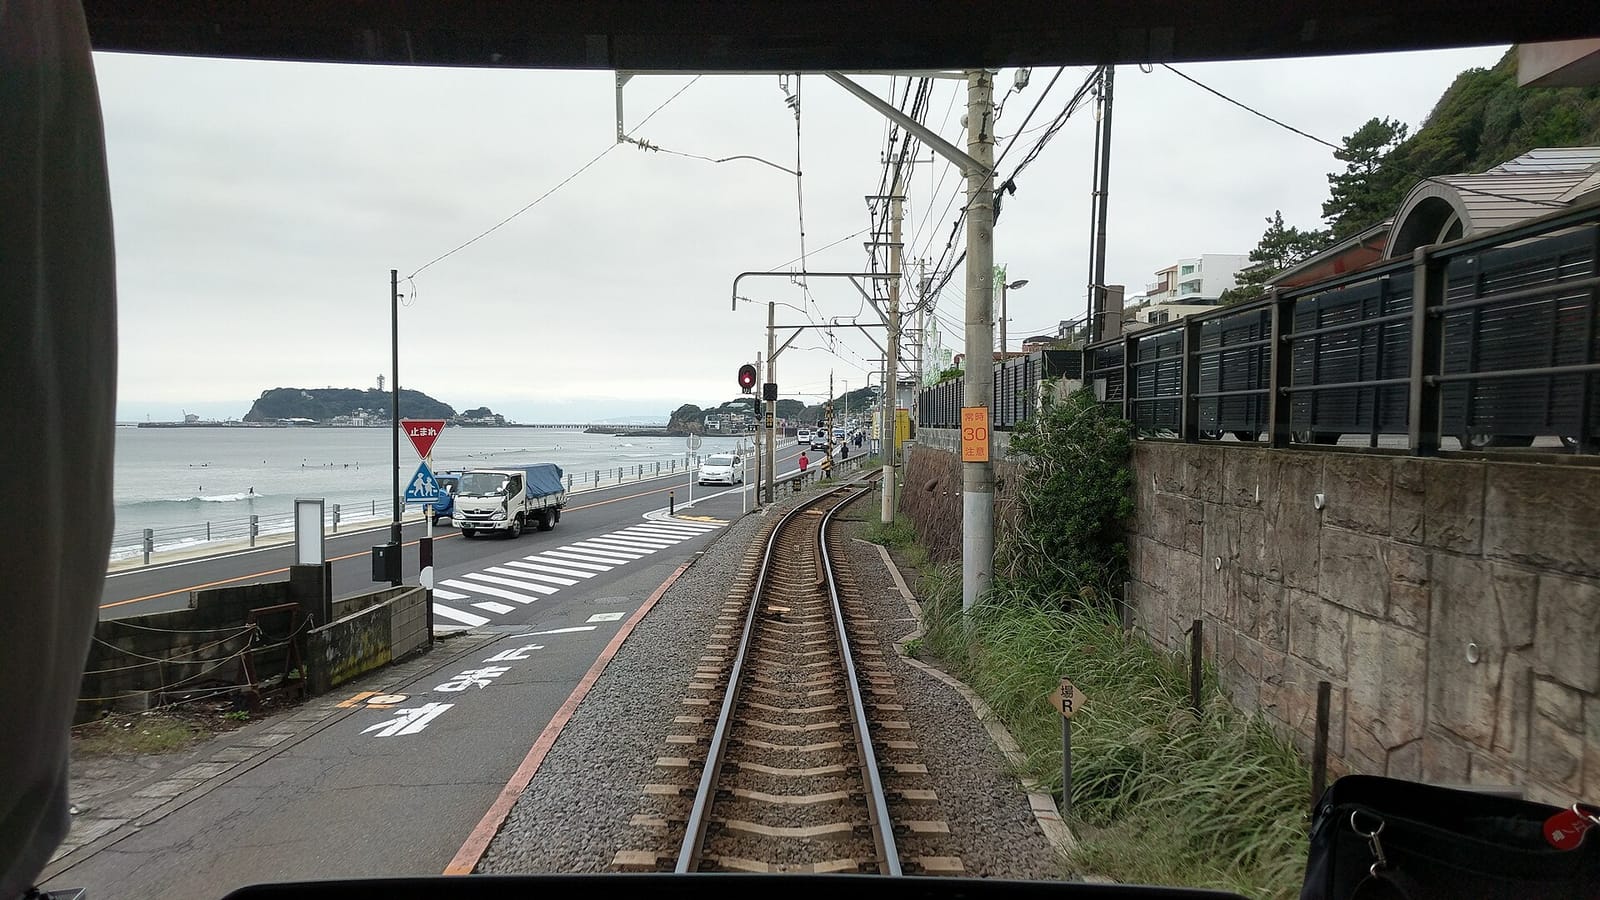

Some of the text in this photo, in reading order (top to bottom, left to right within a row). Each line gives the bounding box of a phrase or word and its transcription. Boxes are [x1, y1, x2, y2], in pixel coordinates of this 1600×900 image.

[410, 427, 437, 437] 止まれ
[963, 427, 987, 441] 30
[964, 446, 985, 457] 注意
[1060, 685, 1074, 699] 場
[1062, 699, 1073, 713] R
